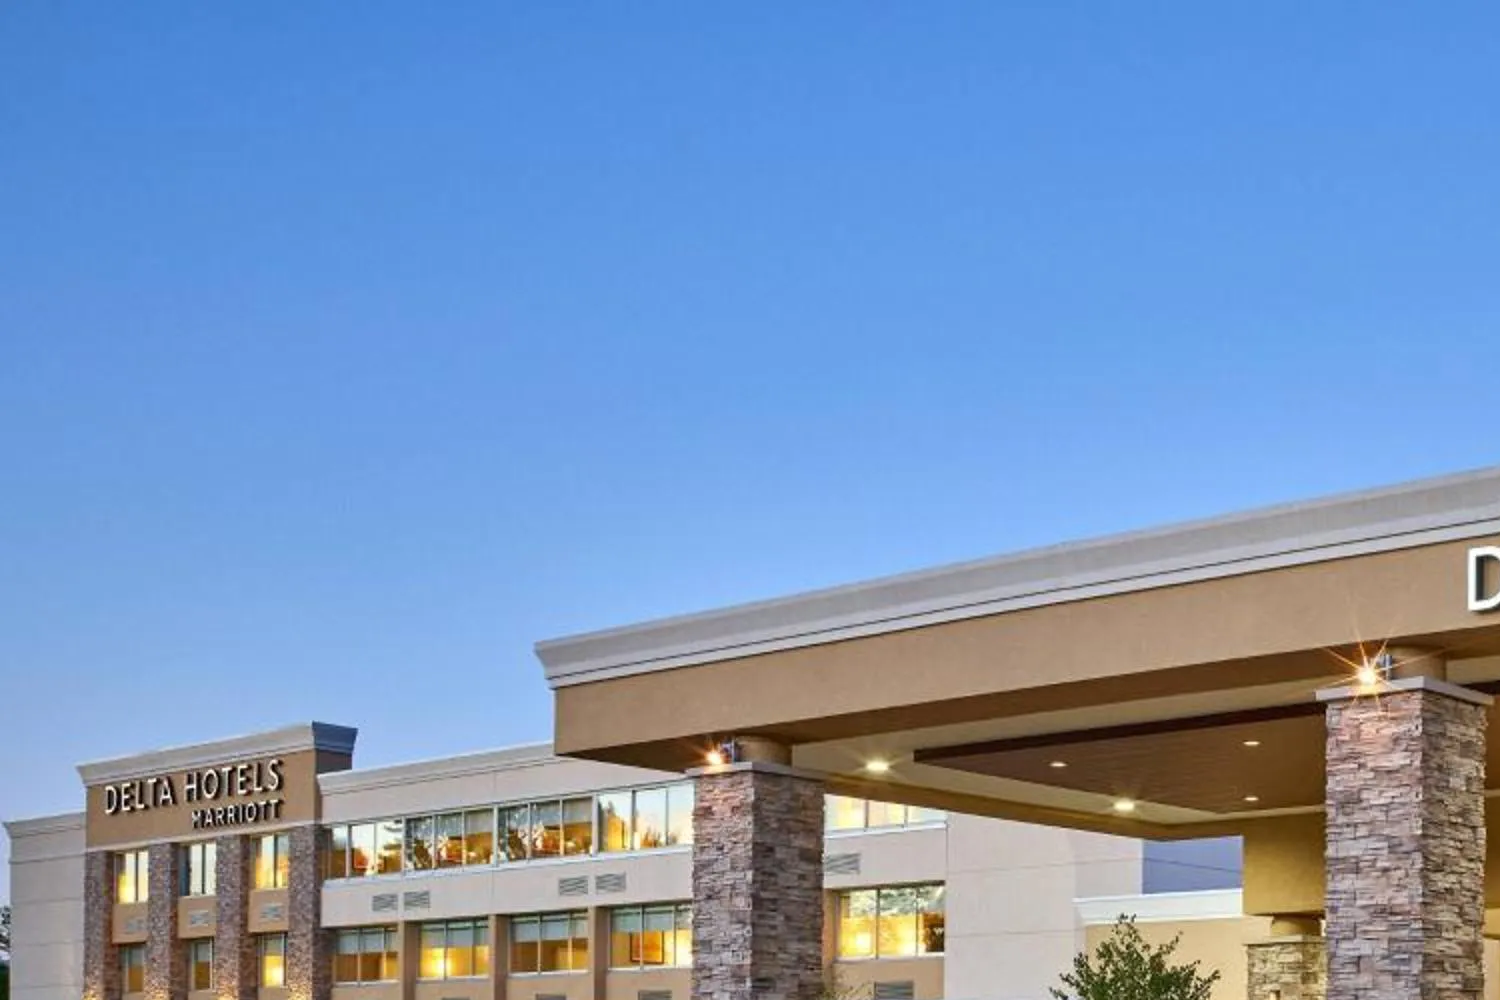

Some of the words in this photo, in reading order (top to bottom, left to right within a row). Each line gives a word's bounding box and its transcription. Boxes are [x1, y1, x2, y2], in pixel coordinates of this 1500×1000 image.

[104, 777, 177, 815] DELTA
[184, 759, 283, 803] HOTELS
[191, 799, 283, 829] MARRIOTT
